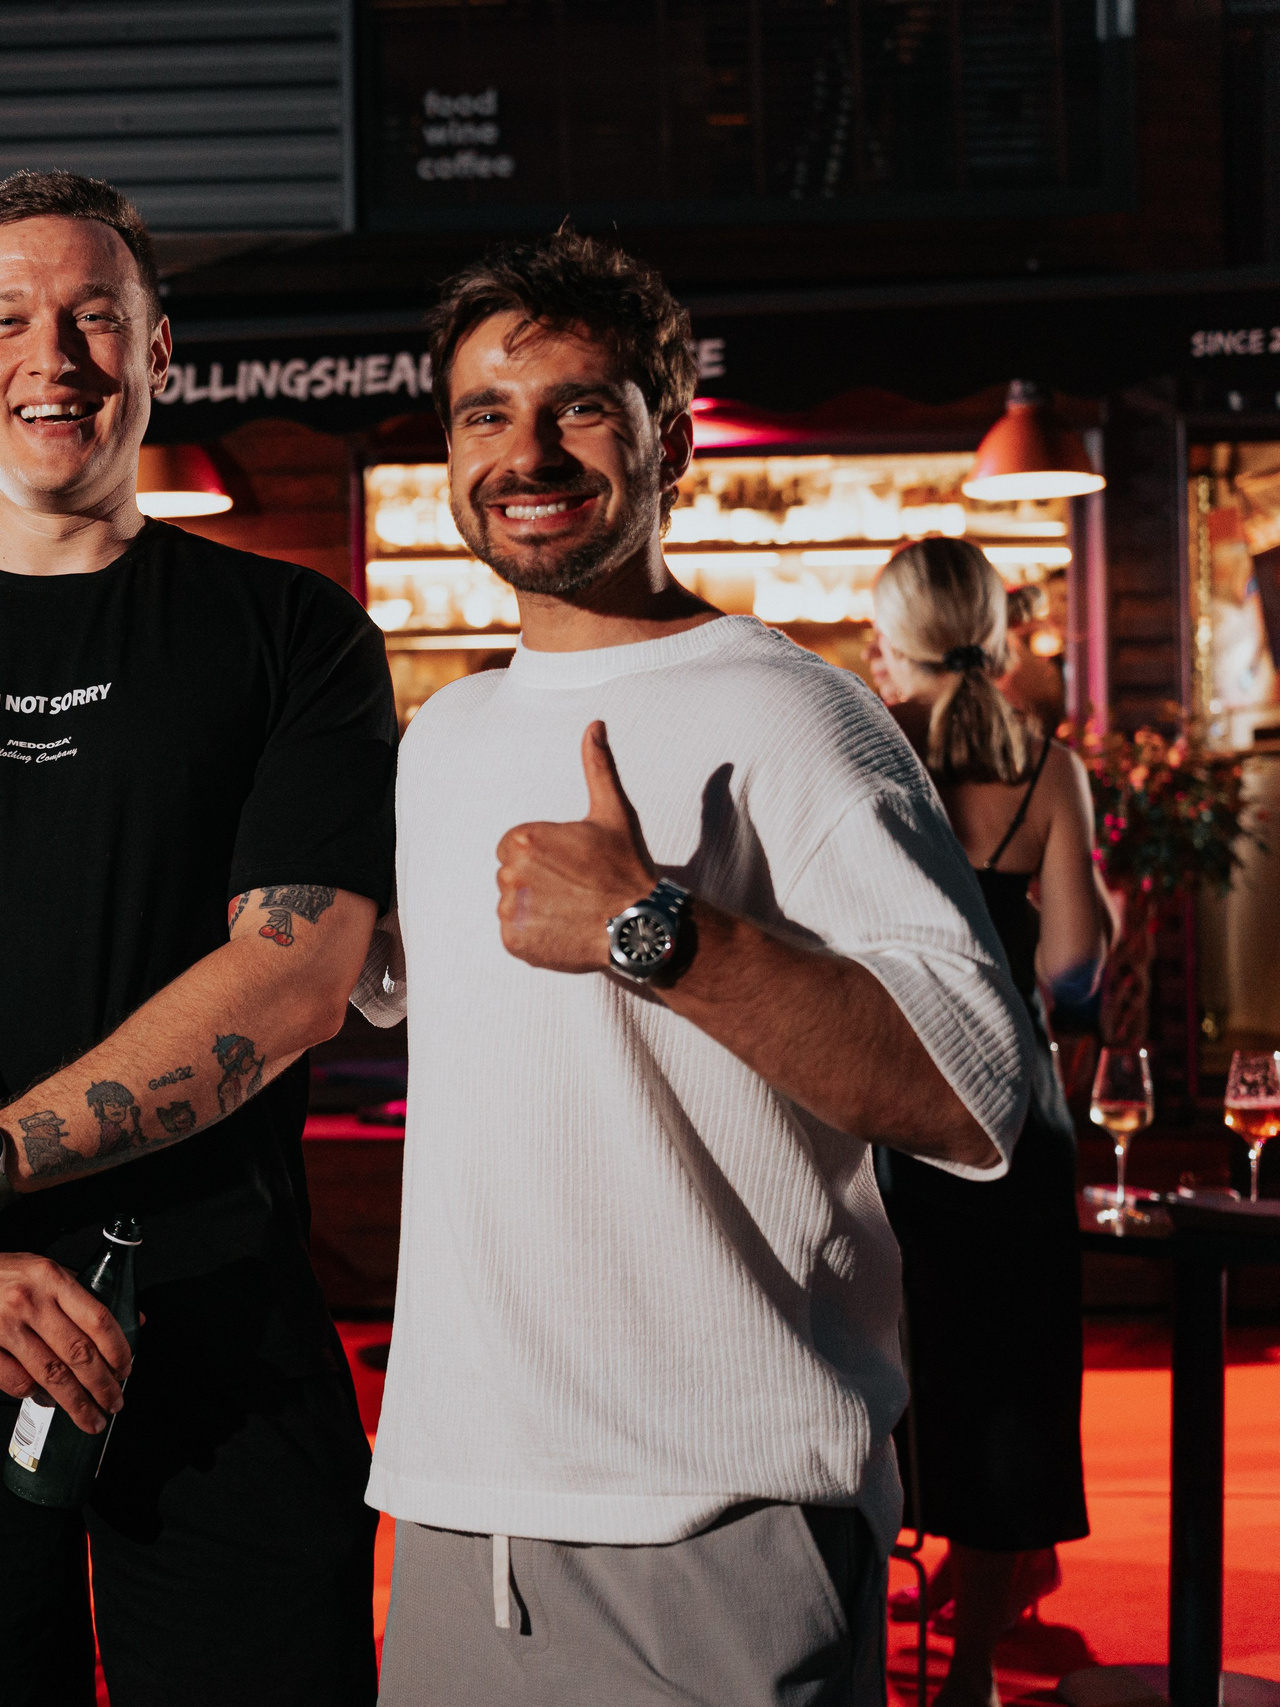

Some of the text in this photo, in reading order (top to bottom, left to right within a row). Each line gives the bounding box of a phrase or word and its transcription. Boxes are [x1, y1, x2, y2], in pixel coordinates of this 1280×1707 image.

[422, 86, 498, 118] food
[421, 120, 499, 147] wine
[415, 149, 517, 181] coffee
[1190, 328, 1265, 358] SINCE
[155, 351, 433, 405] OLLINGSHEA
[5, 694, 48, 714] NOT
[49, 682, 112, 715] SORRY
[35, 746, 78, 764] Company
